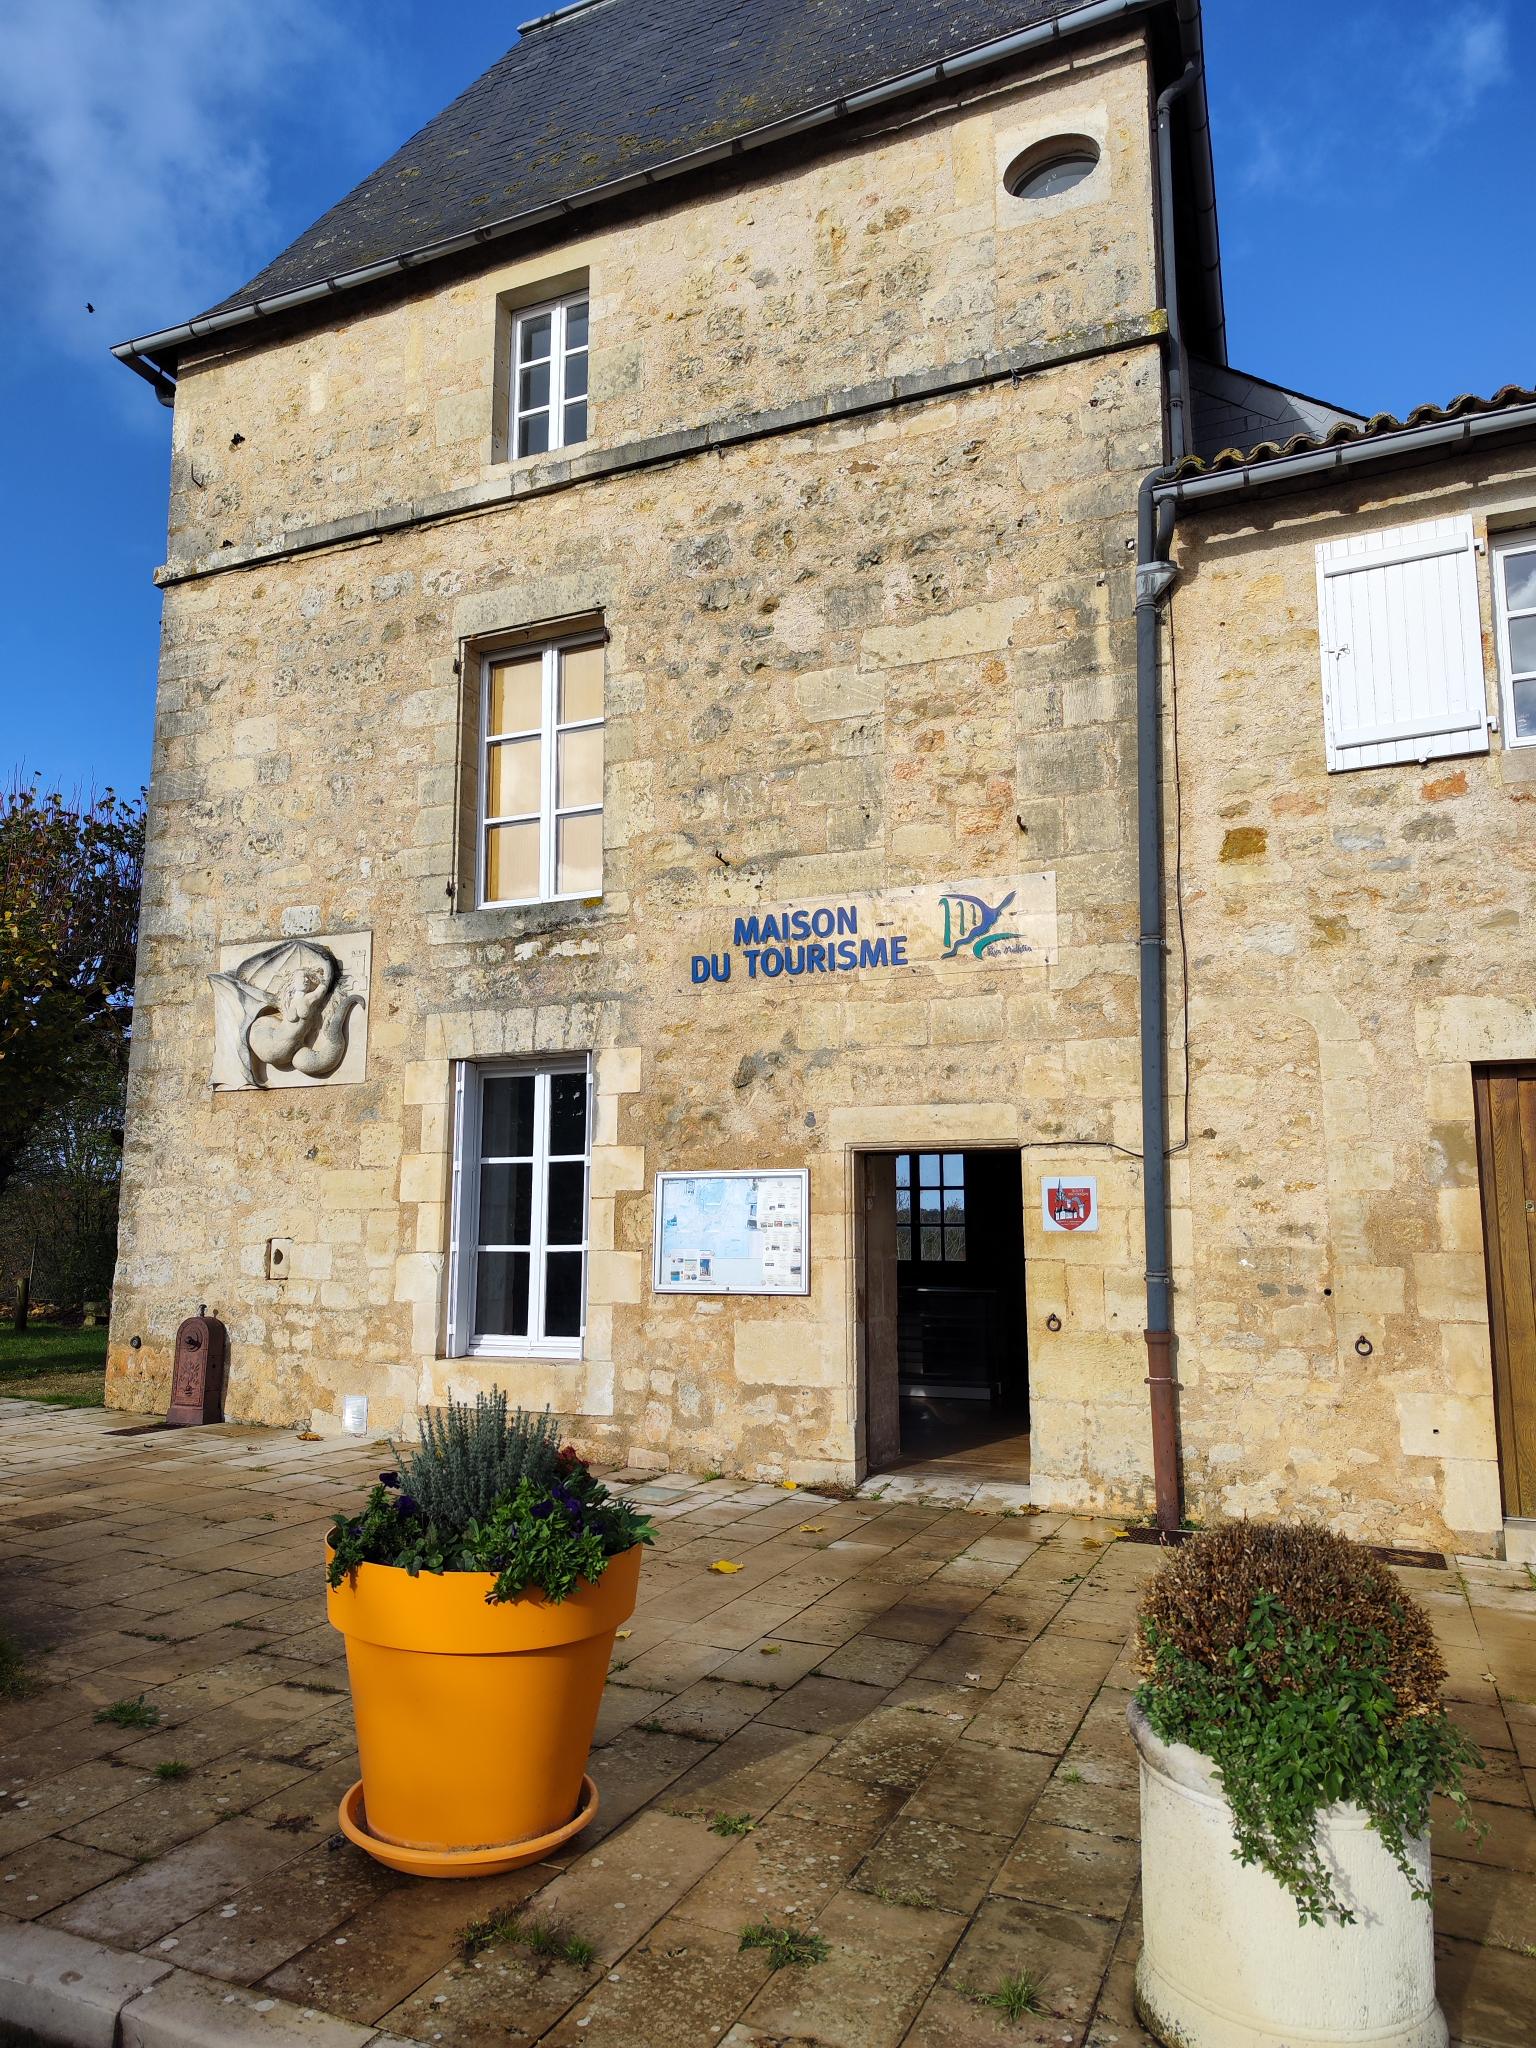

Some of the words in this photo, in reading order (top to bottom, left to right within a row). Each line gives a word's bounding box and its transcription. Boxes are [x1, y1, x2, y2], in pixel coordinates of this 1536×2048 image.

[733, 905, 858, 946] MAISON
[691, 952, 731, 983] DU
[743, 935, 908, 978] TOURISME
